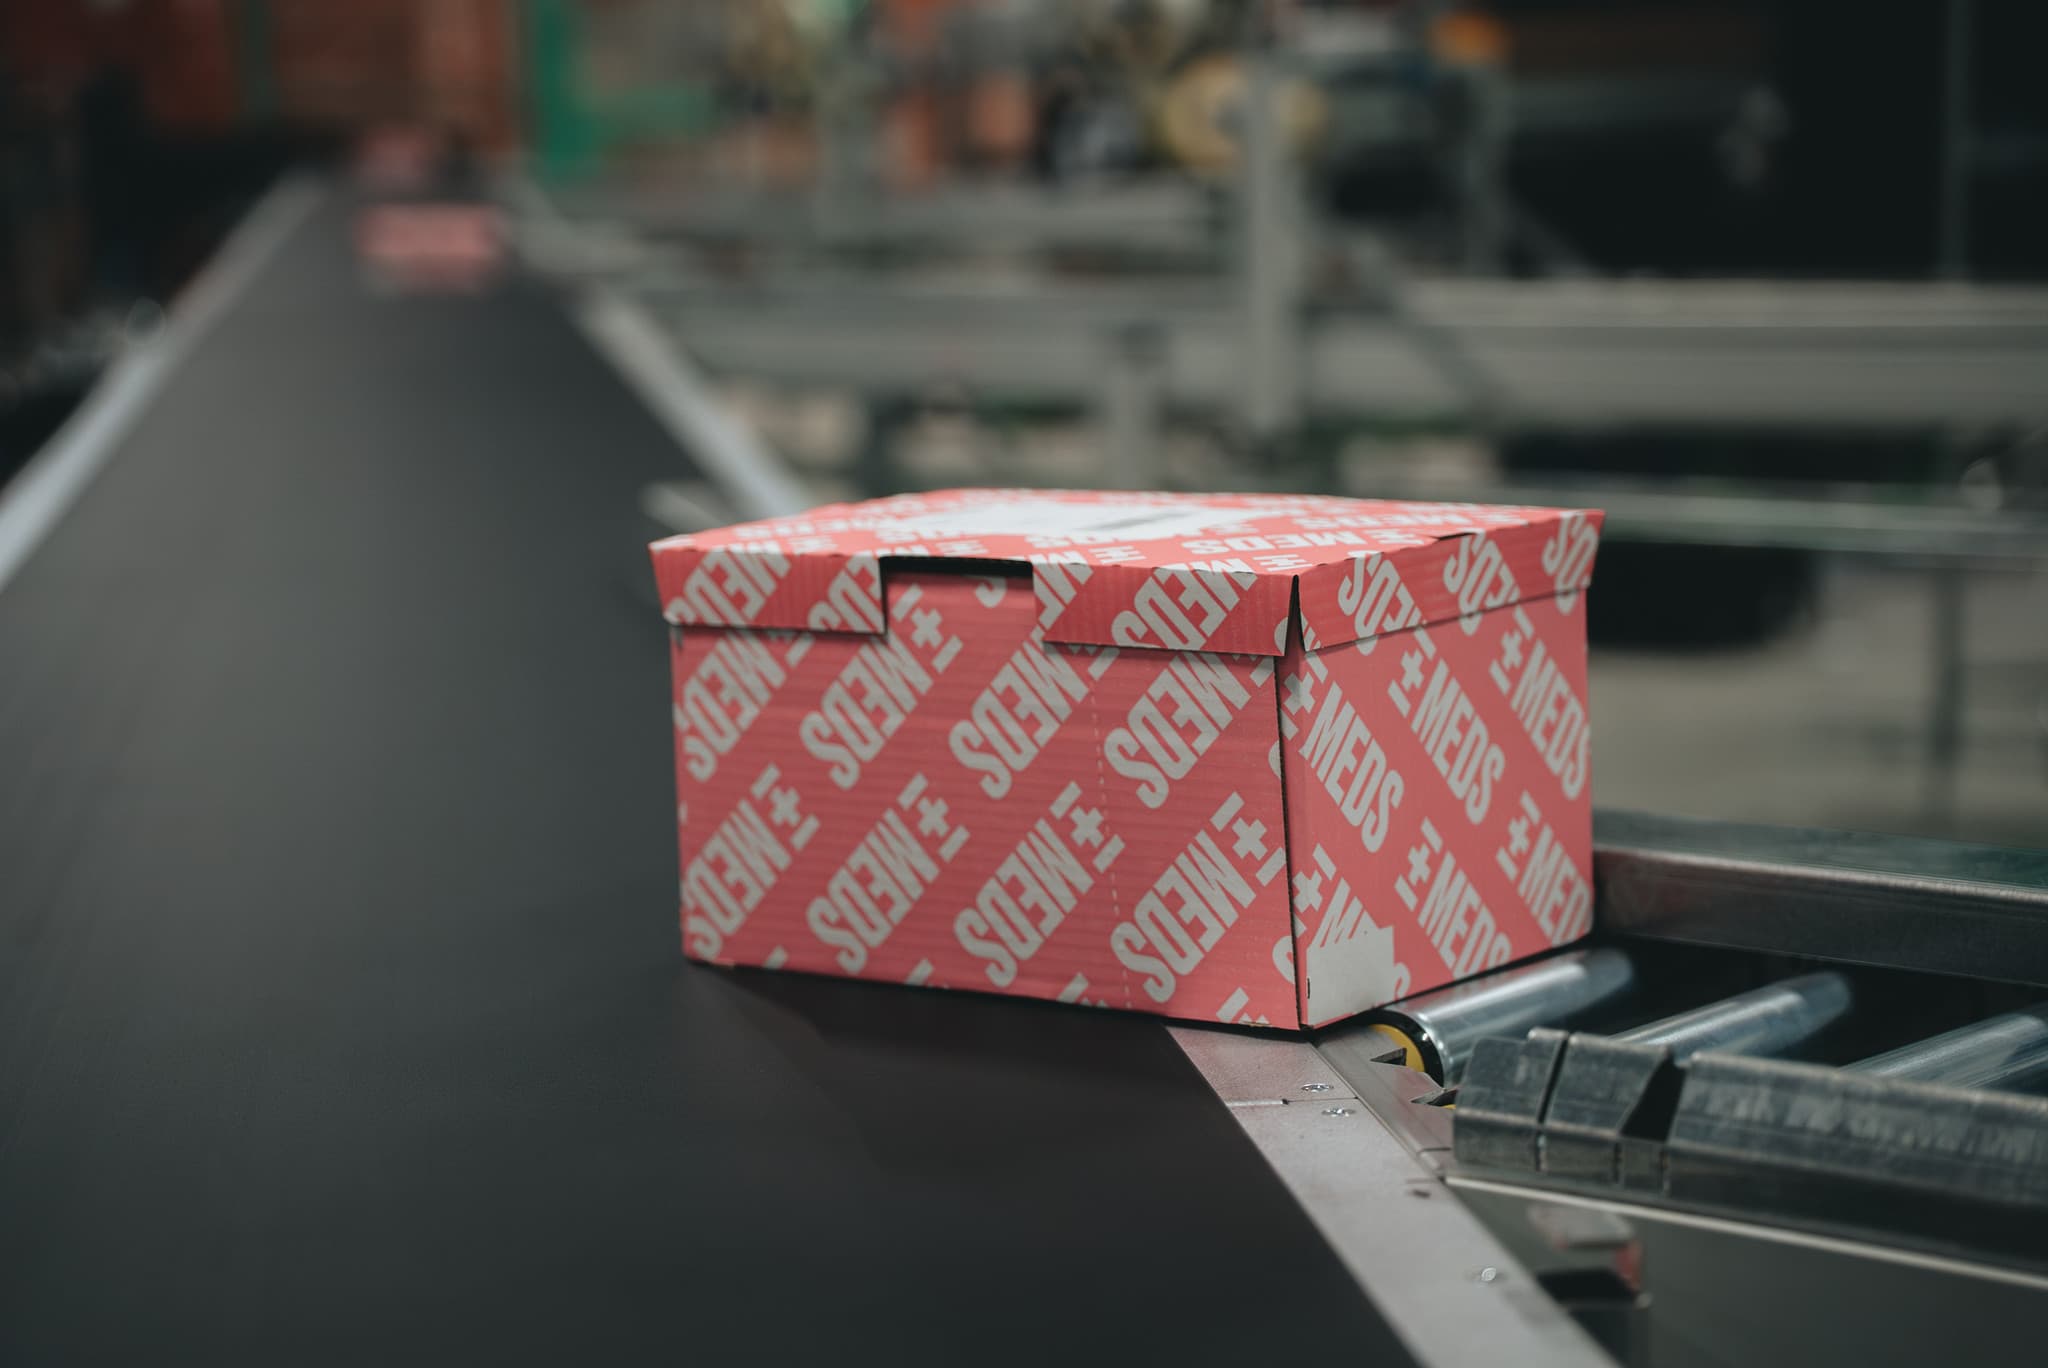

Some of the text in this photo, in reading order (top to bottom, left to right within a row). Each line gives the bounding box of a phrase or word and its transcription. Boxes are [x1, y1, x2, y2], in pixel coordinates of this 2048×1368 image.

[1181, 531, 1367, 554] MEDS
[1338, 550, 1426, 655] EDS
[800, 631, 933, 789] MEDS
[949, 627, 1089, 799] MEDS
[1104, 650, 1251, 808] MEDS
[1299, 681, 1404, 852] MEDS
[1411, 658, 1505, 825] MEDS
[806, 808, 940, 975] MEDS
[953, 818, 1095, 987] MEDS
[1110, 829, 1257, 1003] MEDS
[1518, 825, 1592, 948] MED
